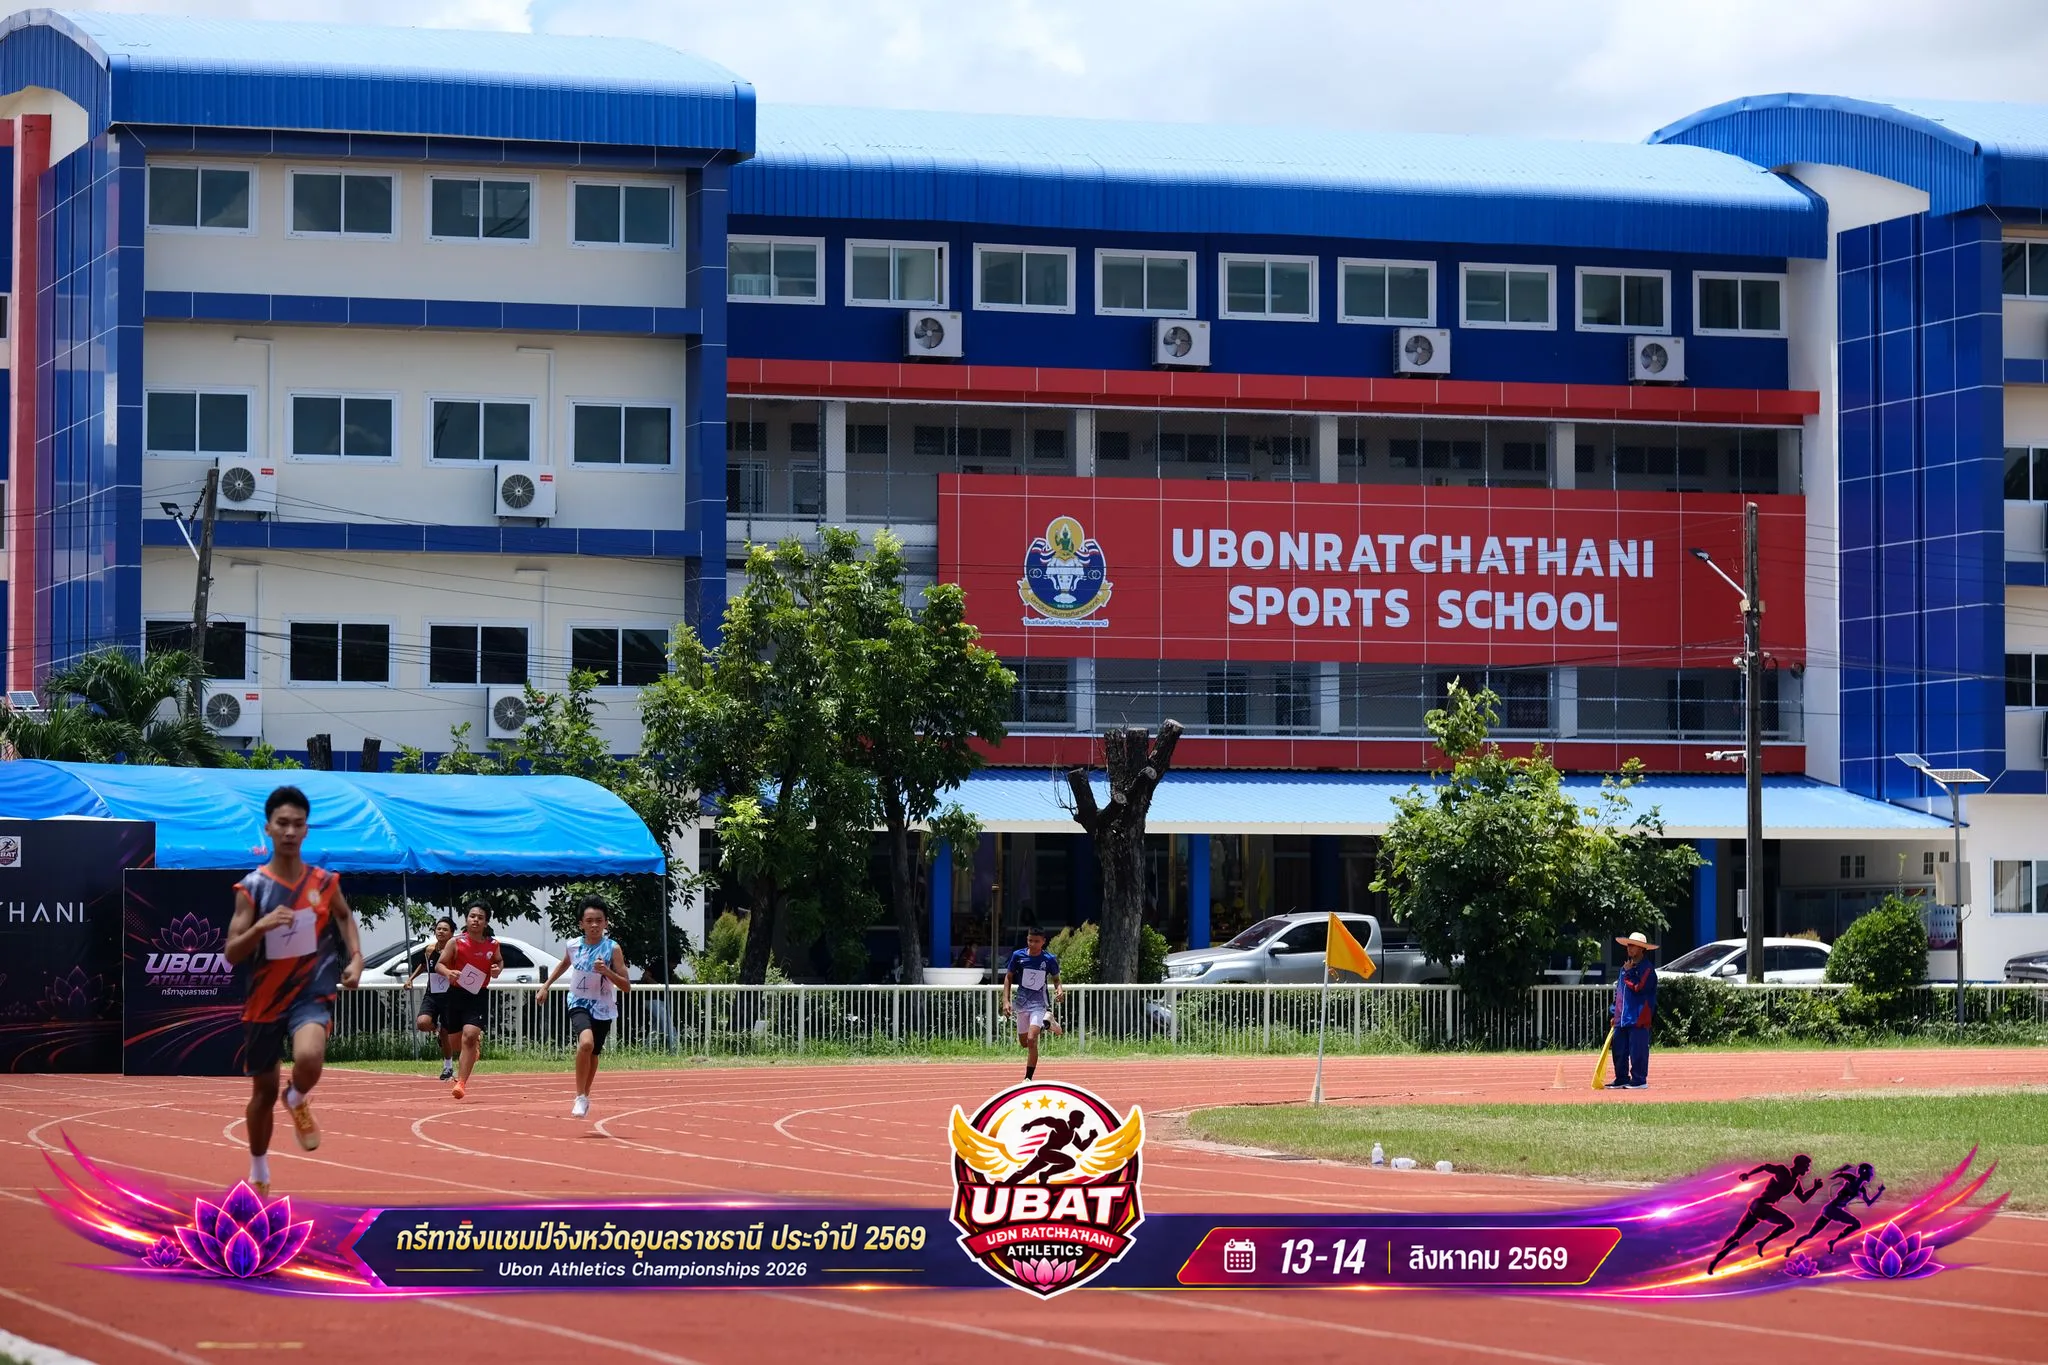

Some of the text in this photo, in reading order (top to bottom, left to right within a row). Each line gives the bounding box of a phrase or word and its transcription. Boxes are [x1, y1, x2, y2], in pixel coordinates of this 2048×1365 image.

[1172, 528, 1654, 578] UBONRATCHATHANI
[1228, 585, 1618, 632] SPORTS SCHOOL
[0, 901, 84, 923] HANI
[145, 952, 234, 974] UBON
[146, 974, 235, 987] ATHLETICS
[463, 971, 479, 986] 5
[576, 975, 590, 993] 4
[1028, 971, 1037, 988] 3
